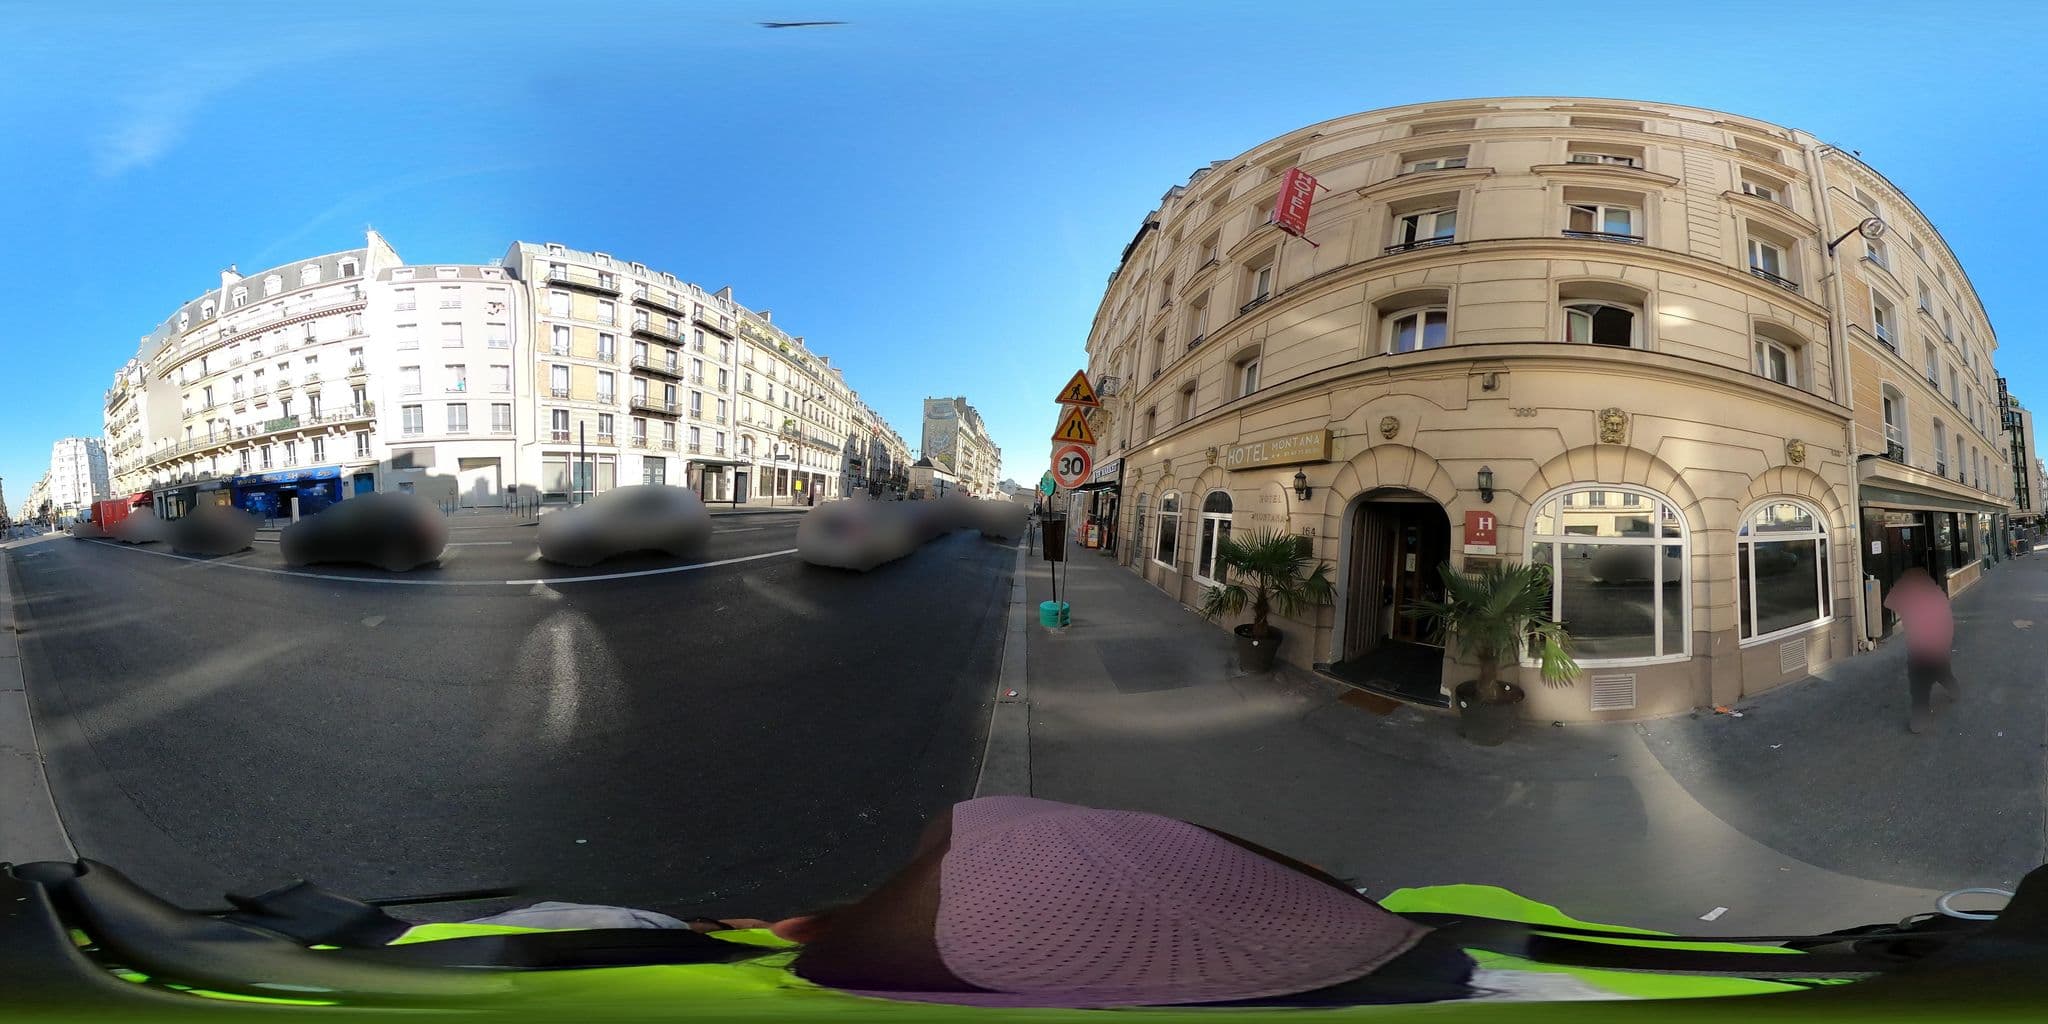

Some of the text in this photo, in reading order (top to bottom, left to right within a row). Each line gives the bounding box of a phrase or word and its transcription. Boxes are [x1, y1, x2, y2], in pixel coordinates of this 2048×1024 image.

[1289, 172, 1313, 219] HOTEL
[1228, 443, 1269, 465] HOTEL
[1271, 434, 1320, 451] MONTANA
[1060, 457, 1084, 476] 30
[1302, 526, 1316, 536] 164
[1479, 517, 1493, 530] H
